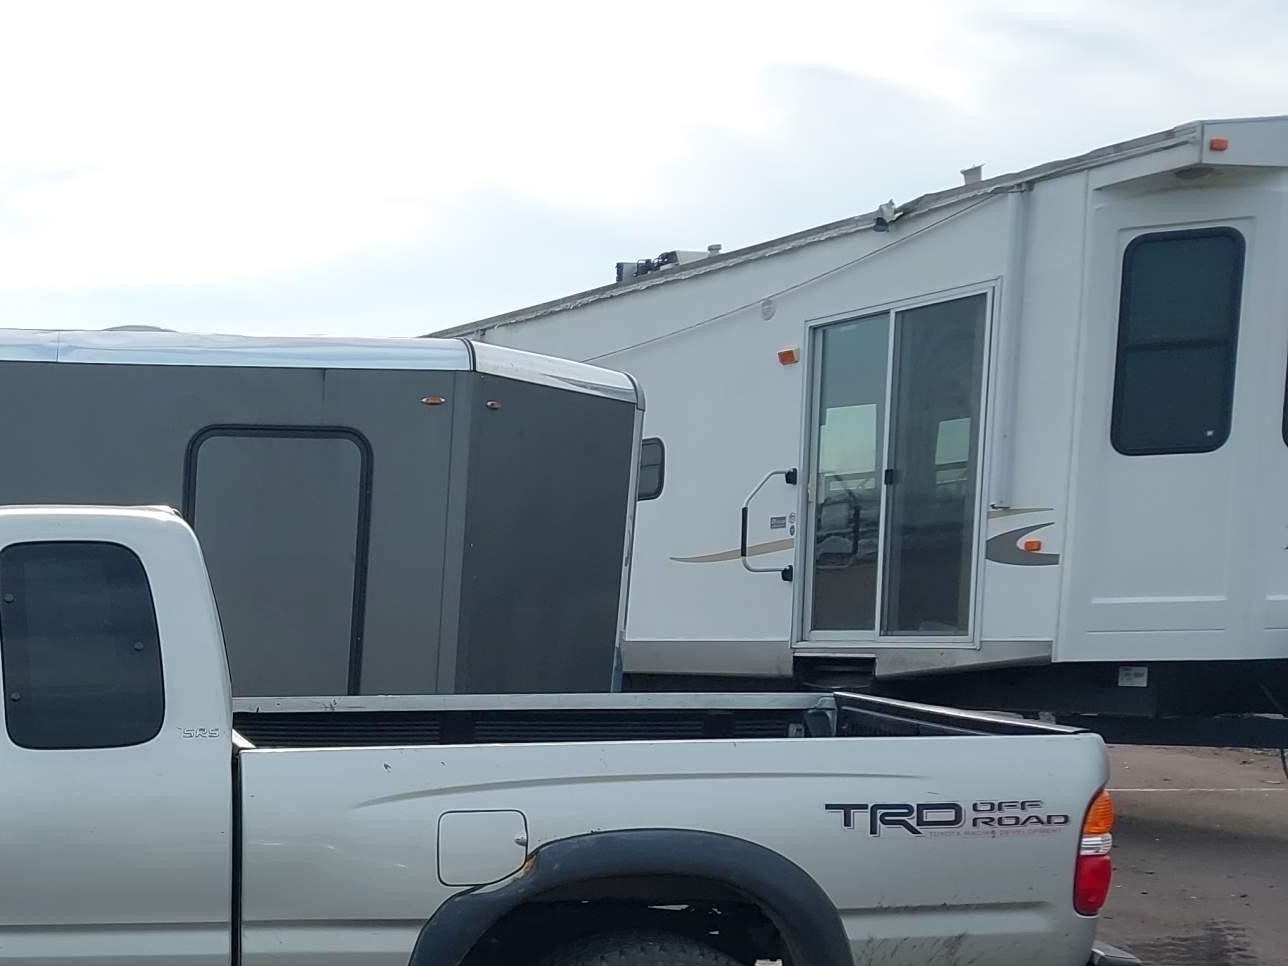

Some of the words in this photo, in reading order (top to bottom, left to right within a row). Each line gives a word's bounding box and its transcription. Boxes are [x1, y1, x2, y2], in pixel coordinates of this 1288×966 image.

[972, 799, 1043, 812] OFF
[824, 802, 963, 836] TRD
[971, 814, 1070, 828] ROAD
